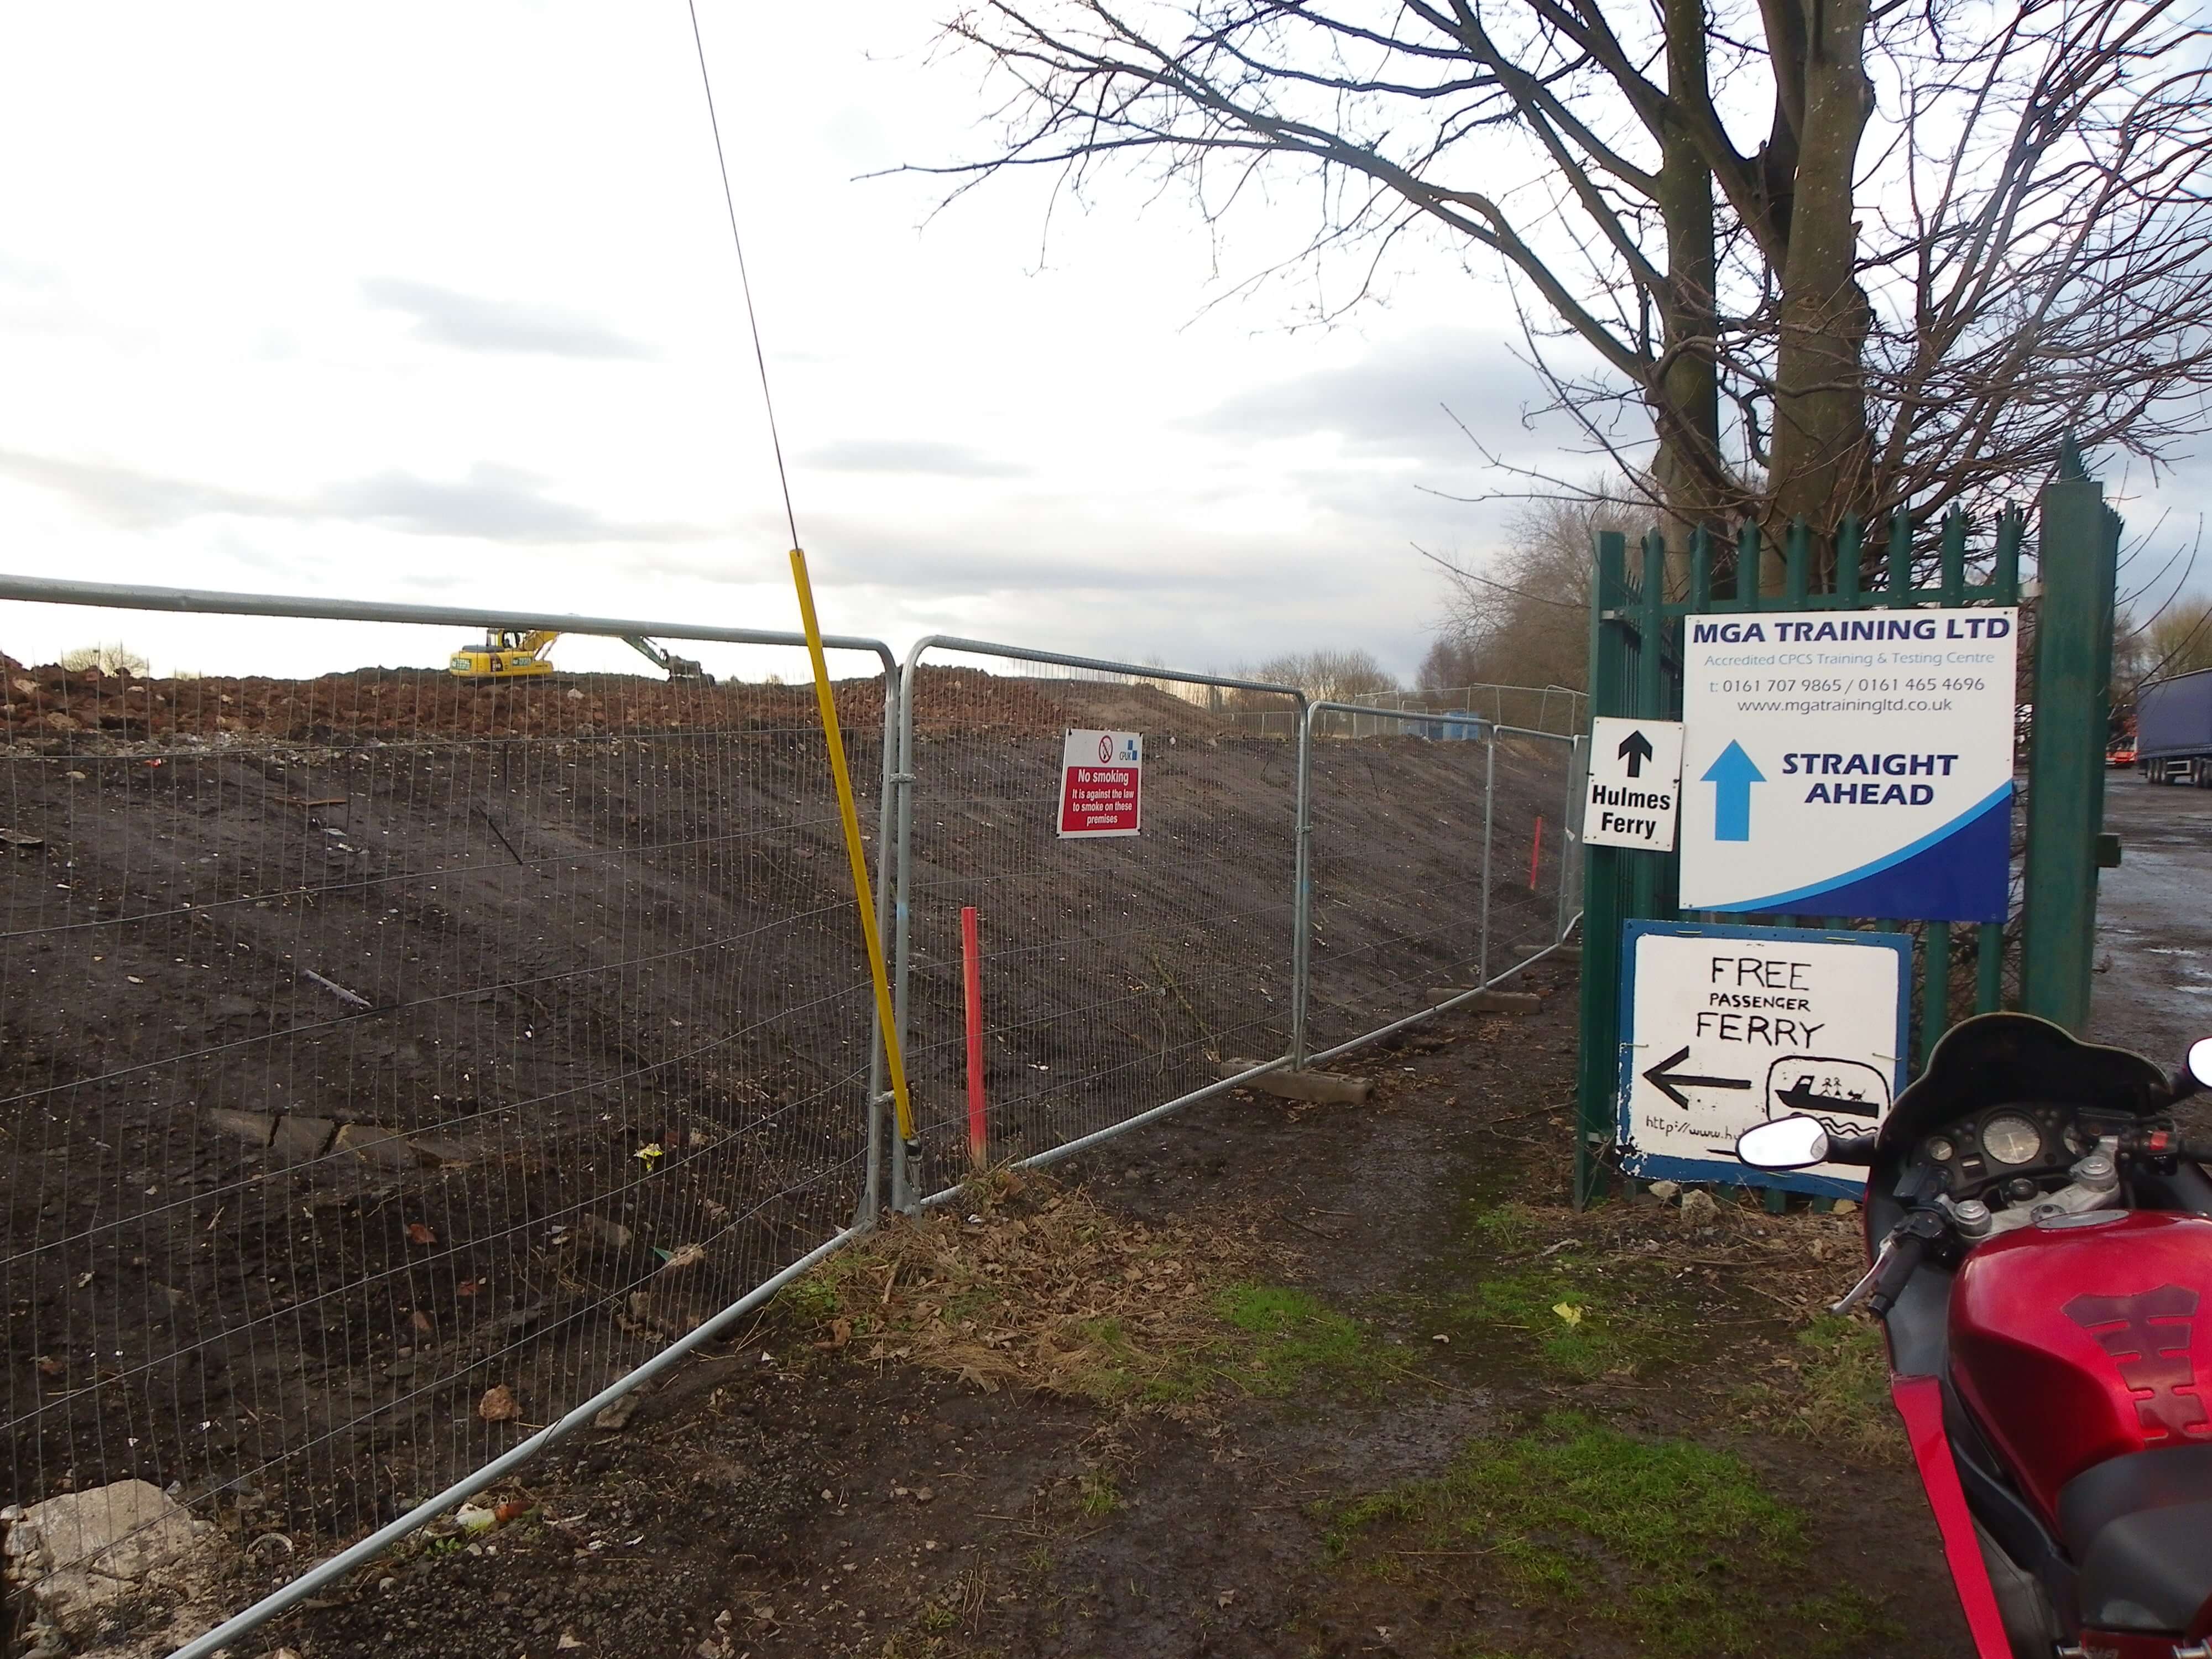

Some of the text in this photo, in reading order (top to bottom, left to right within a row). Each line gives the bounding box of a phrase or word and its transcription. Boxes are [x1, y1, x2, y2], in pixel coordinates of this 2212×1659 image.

[1693, 618, 2011, 643] MGA TRAINING LTD
[1704, 652, 1995, 666] Accredited CPCS Training & Testing Centre
[1710, 678, 1985, 695] t: 0161 707 9865 / 0161 465 4696
[1738, 699, 1952, 714] www.mgatrainingltd.co.uk
[1782, 753, 1958, 775] STRAIGHT
[1078, 769, 1129, 786] No smoking
[1072, 789, 1134, 801] It is against the law
[1592, 785, 1671, 811] Hulmes
[1804, 782, 1934, 805] AHEAD
[1073, 802, 1080, 812] to
[1081, 802, 1103, 811] smoke
[1114, 801, 1132, 811] these
[1087, 814, 1118, 827] premises
[1601, 812, 1656, 840] Ferry
[1712, 957, 1812, 990] FREE
[1710, 993, 1811, 1012] PASSENGER
[1697, 1012, 1825, 1048] FERRY
